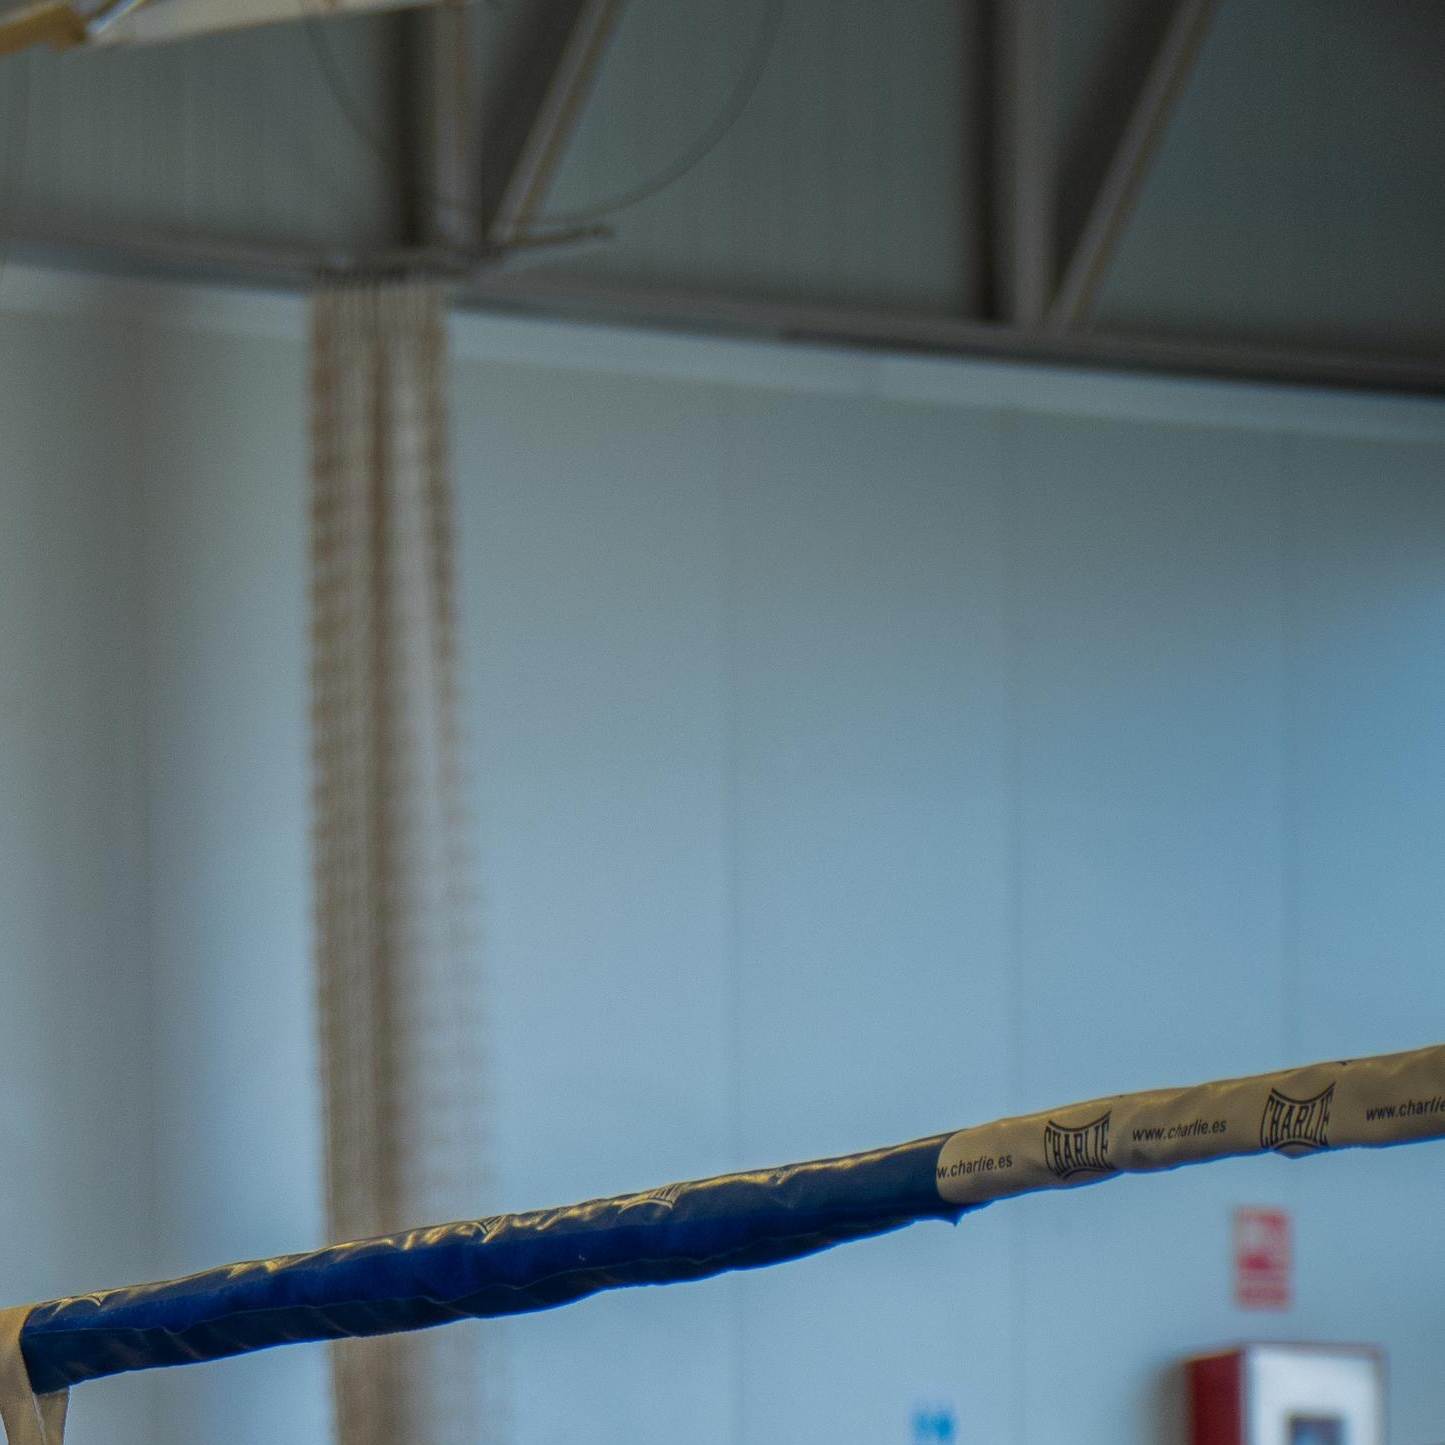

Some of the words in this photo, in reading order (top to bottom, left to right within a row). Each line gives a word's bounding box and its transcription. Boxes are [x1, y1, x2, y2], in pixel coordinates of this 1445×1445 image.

[1044, 1111, 1116, 1180] CHARLIE
[1132, 1118, 1227, 1142] www.charlie.es
[1261, 1083, 1336, 1151] CHARLIE
